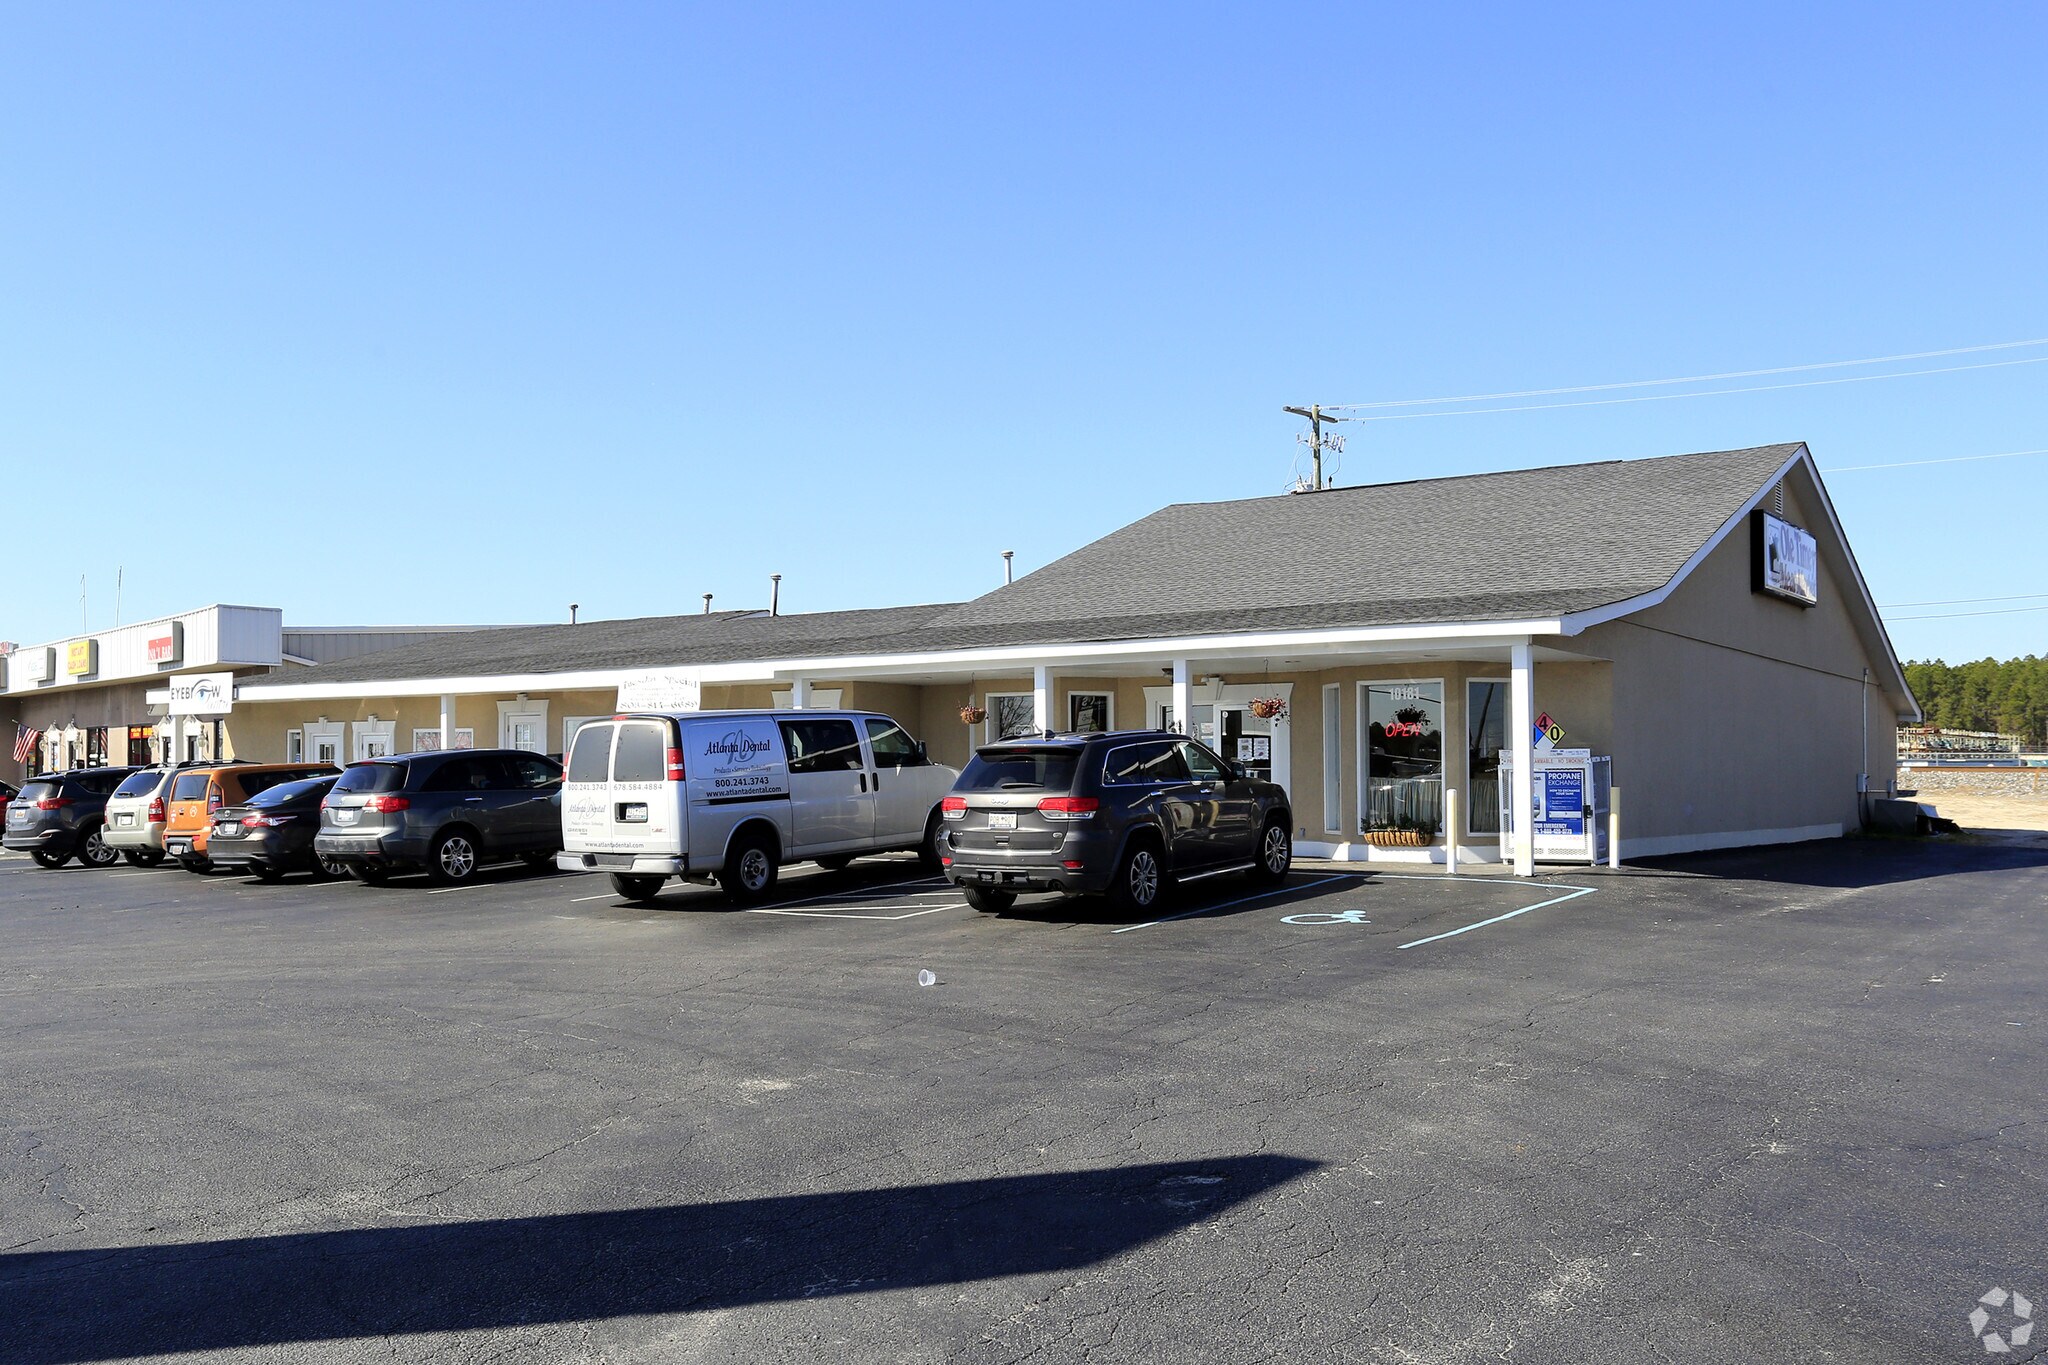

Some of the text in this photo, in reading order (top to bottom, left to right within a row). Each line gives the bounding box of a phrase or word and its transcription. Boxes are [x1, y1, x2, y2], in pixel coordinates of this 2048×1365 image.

[1390, 687, 1420, 700] 10181
[1539, 716, 1548, 730] 4
[1385, 722, 1421, 737] OPEN
[1550, 726, 1560, 741] 0
[704, 739, 771, 756] Atlanta Dental
[715, 776, 769, 788] 800.241.3743
[1548, 772, 1581, 780] PROPANE
[567, 783, 663, 791] 800.241.3743 678.584.4884
[706, 786, 782, 798] www.atlantadental.com
[584, 841, 645, 850] www.atlantadental.com
